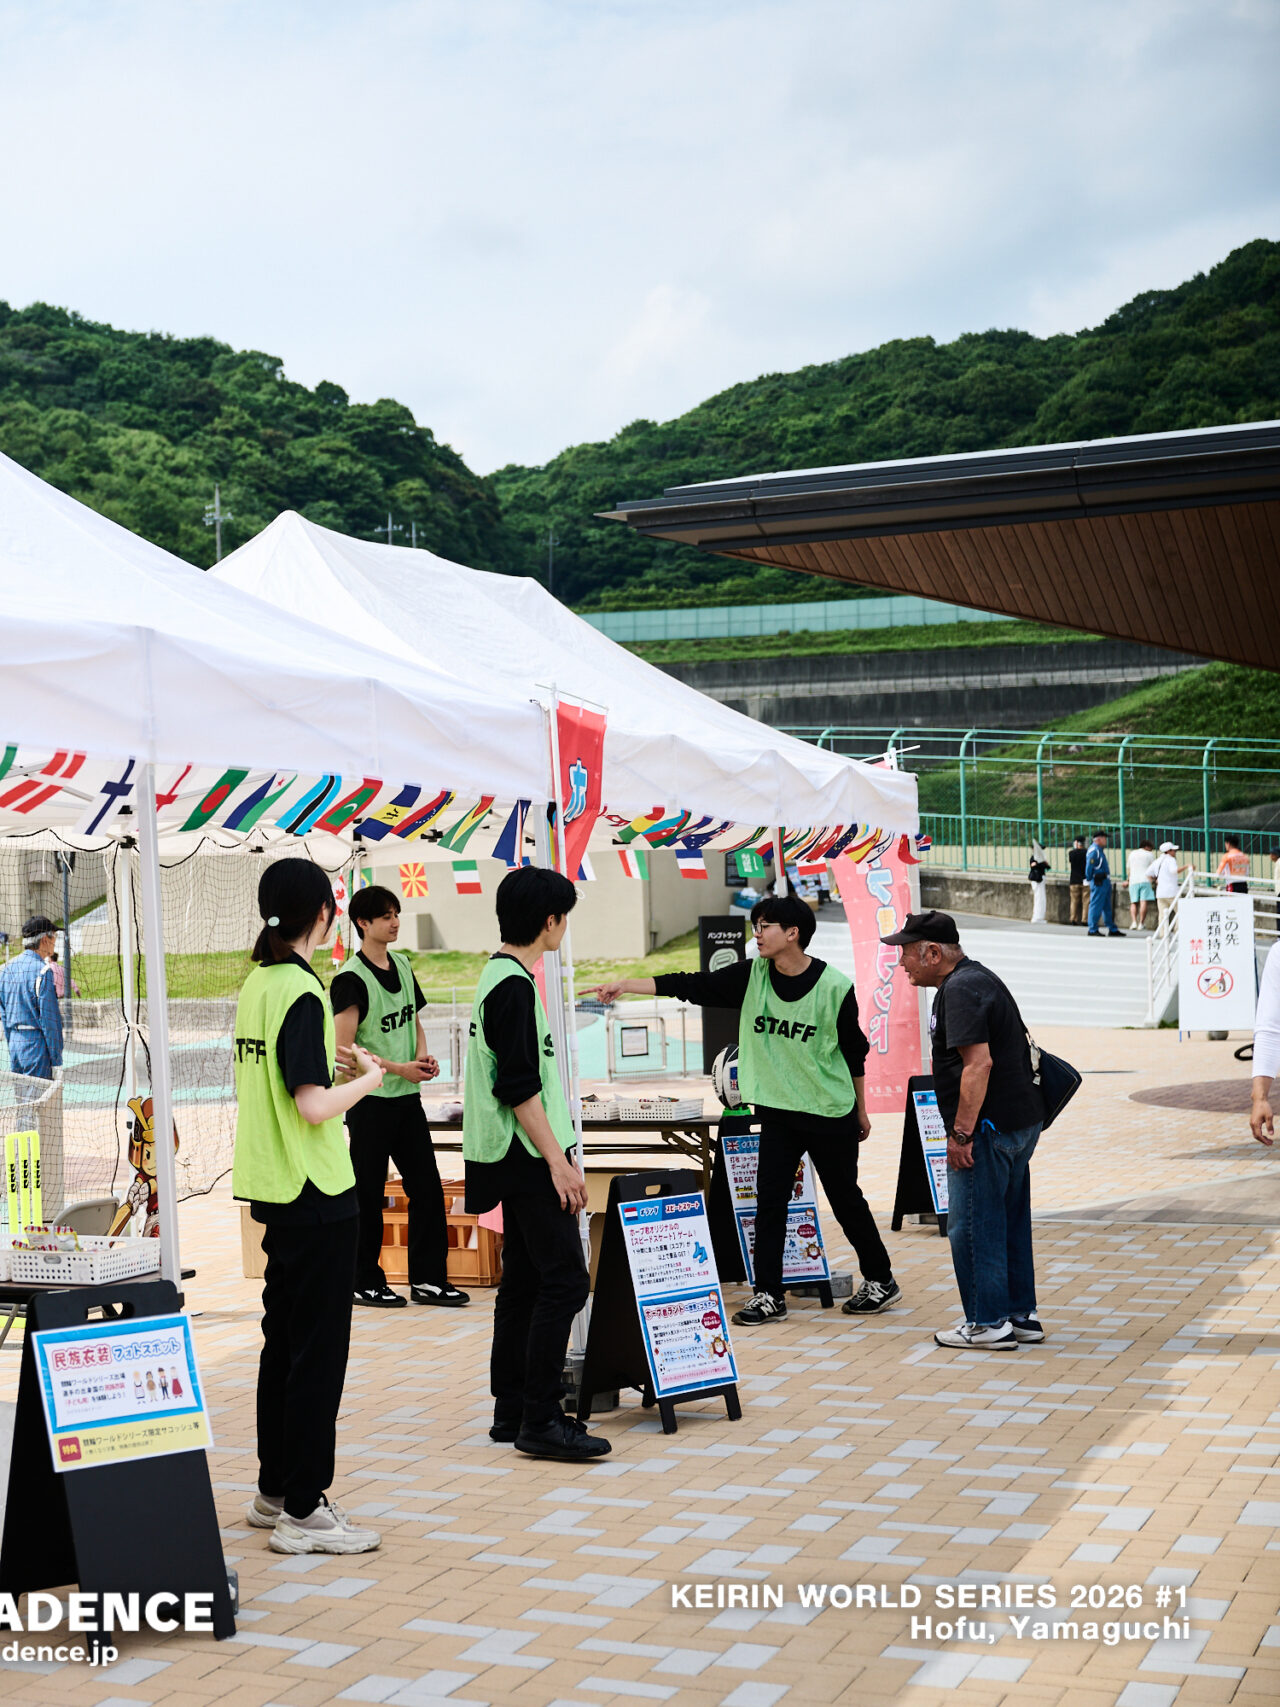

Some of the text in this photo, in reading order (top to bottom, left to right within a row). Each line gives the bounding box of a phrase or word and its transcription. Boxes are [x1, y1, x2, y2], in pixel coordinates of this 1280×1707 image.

[1207, 911, 1222, 965] 酒類持込
[1225, 909, 1240, 946] この先
[1190, 938, 1204, 965] 禁止
[753, 1015, 818, 1043] STAFF
[52, 1337, 182, 1371] 民族衣装 フォトスポット
